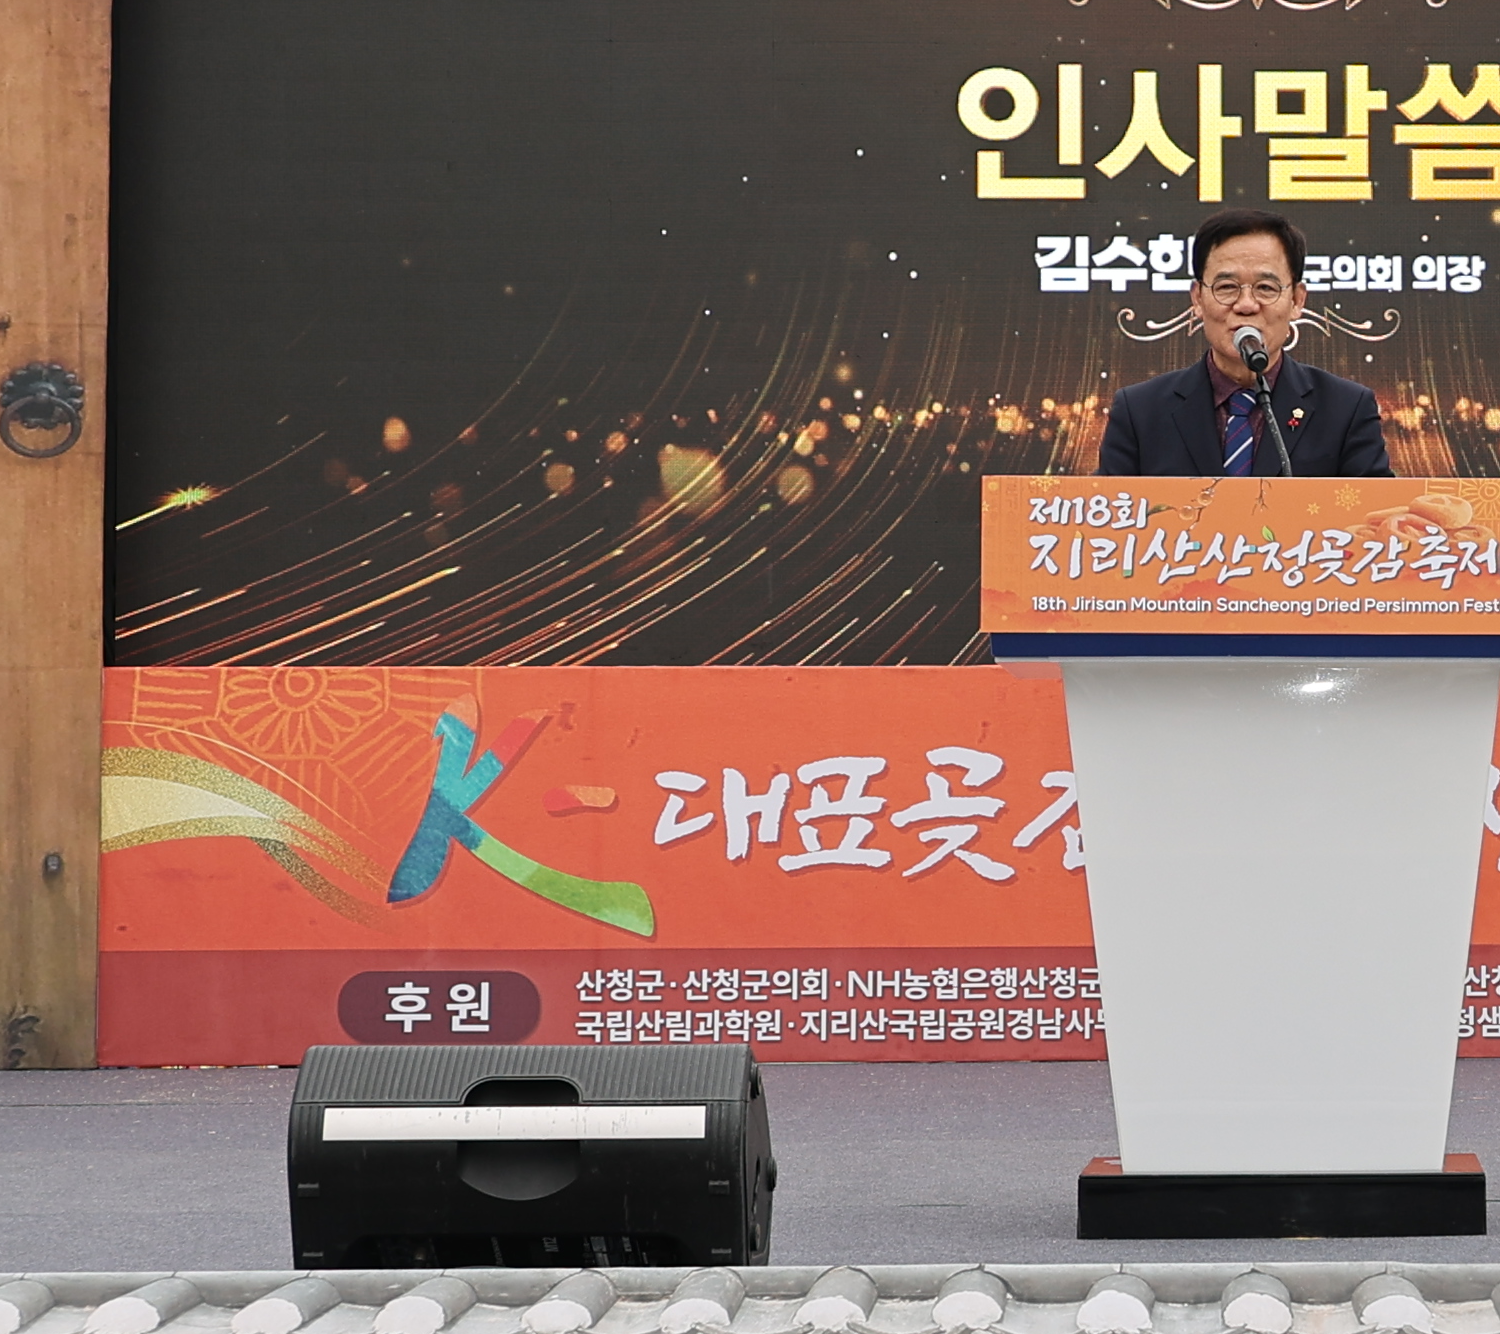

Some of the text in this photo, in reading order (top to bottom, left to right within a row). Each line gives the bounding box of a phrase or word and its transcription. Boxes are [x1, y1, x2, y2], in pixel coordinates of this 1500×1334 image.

[1411, 255, 1485, 293] 의장
[1028, 492, 1149, 529] 제18회
[1031, 597, 1066, 612] 18th
[1071, 597, 1127, 612] Jirisan
[1130, 597, 1212, 613] Mountain
[1216, 597, 1312, 616] Sancheong
[1316, 598, 1360, 613] Dried
[1364, 599, 1460, 613] Persimmon
[384, 981, 490, 1033] 후원
